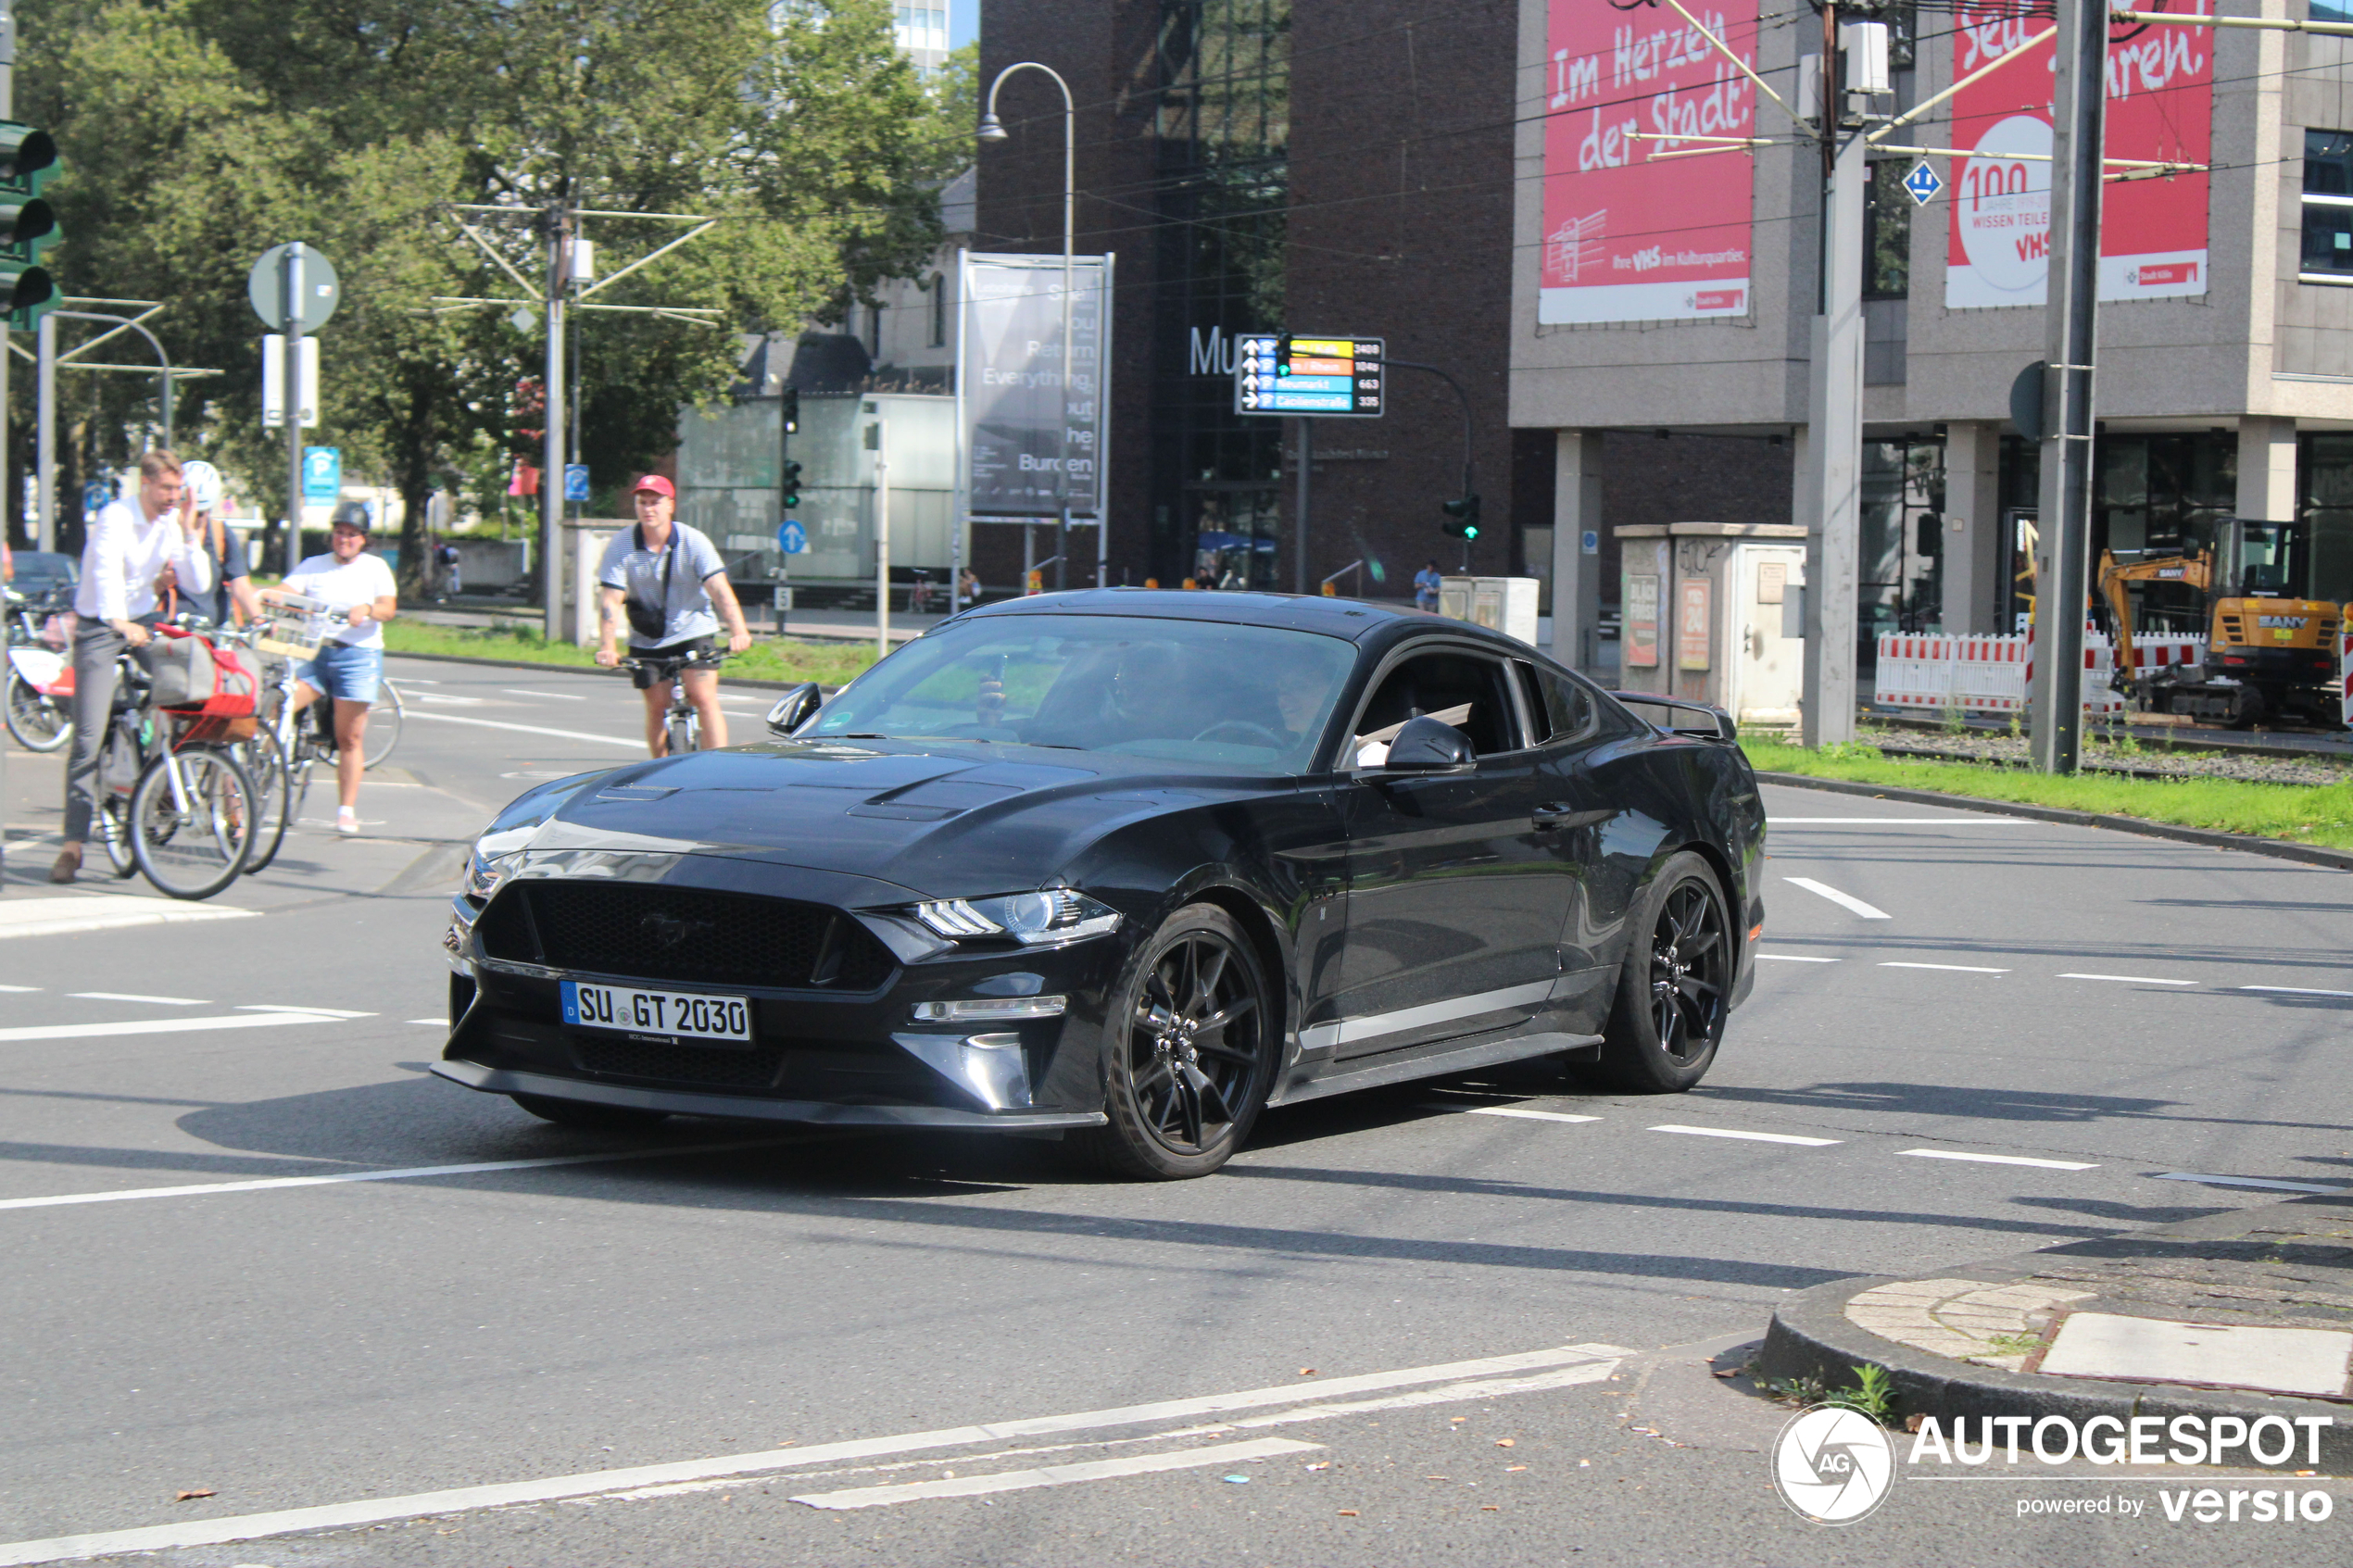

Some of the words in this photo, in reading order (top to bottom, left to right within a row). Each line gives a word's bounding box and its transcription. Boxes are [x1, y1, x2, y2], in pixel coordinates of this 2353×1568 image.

[1551, 48, 1599, 109] Im
[1614, 9, 1729, 89] Herzen
[1579, 104, 1638, 175] der
[1651, 52, 1751, 156] Stadt!
[1968, 162, 2027, 212] 100
[1972, 214, 2015, 229] WISSEN
[2018, 211, 2048, 226] TEILE
[1613, 255, 1631, 269] Ihre
[1632, 245, 1661, 271] VHS
[1662, 253, 1675, 266] im
[1677, 248, 1745, 267] Kulturquartier.
[1048, 284, 1095, 302] Sall
[1027, 340, 1094, 358] Retrn
[1190, 325, 1236, 375] Mu
[983, 368, 1094, 393] Everythng,
[1066, 427, 1093, 444] he
[2159, 568, 2183, 579] SANY
[2258, 615, 2309, 630] SANY
[567, 1006, 574, 1017] D
[580, 987, 613, 1023] SU
[633, 994, 666, 1029] GT
[674, 997, 747, 1035] 2030
